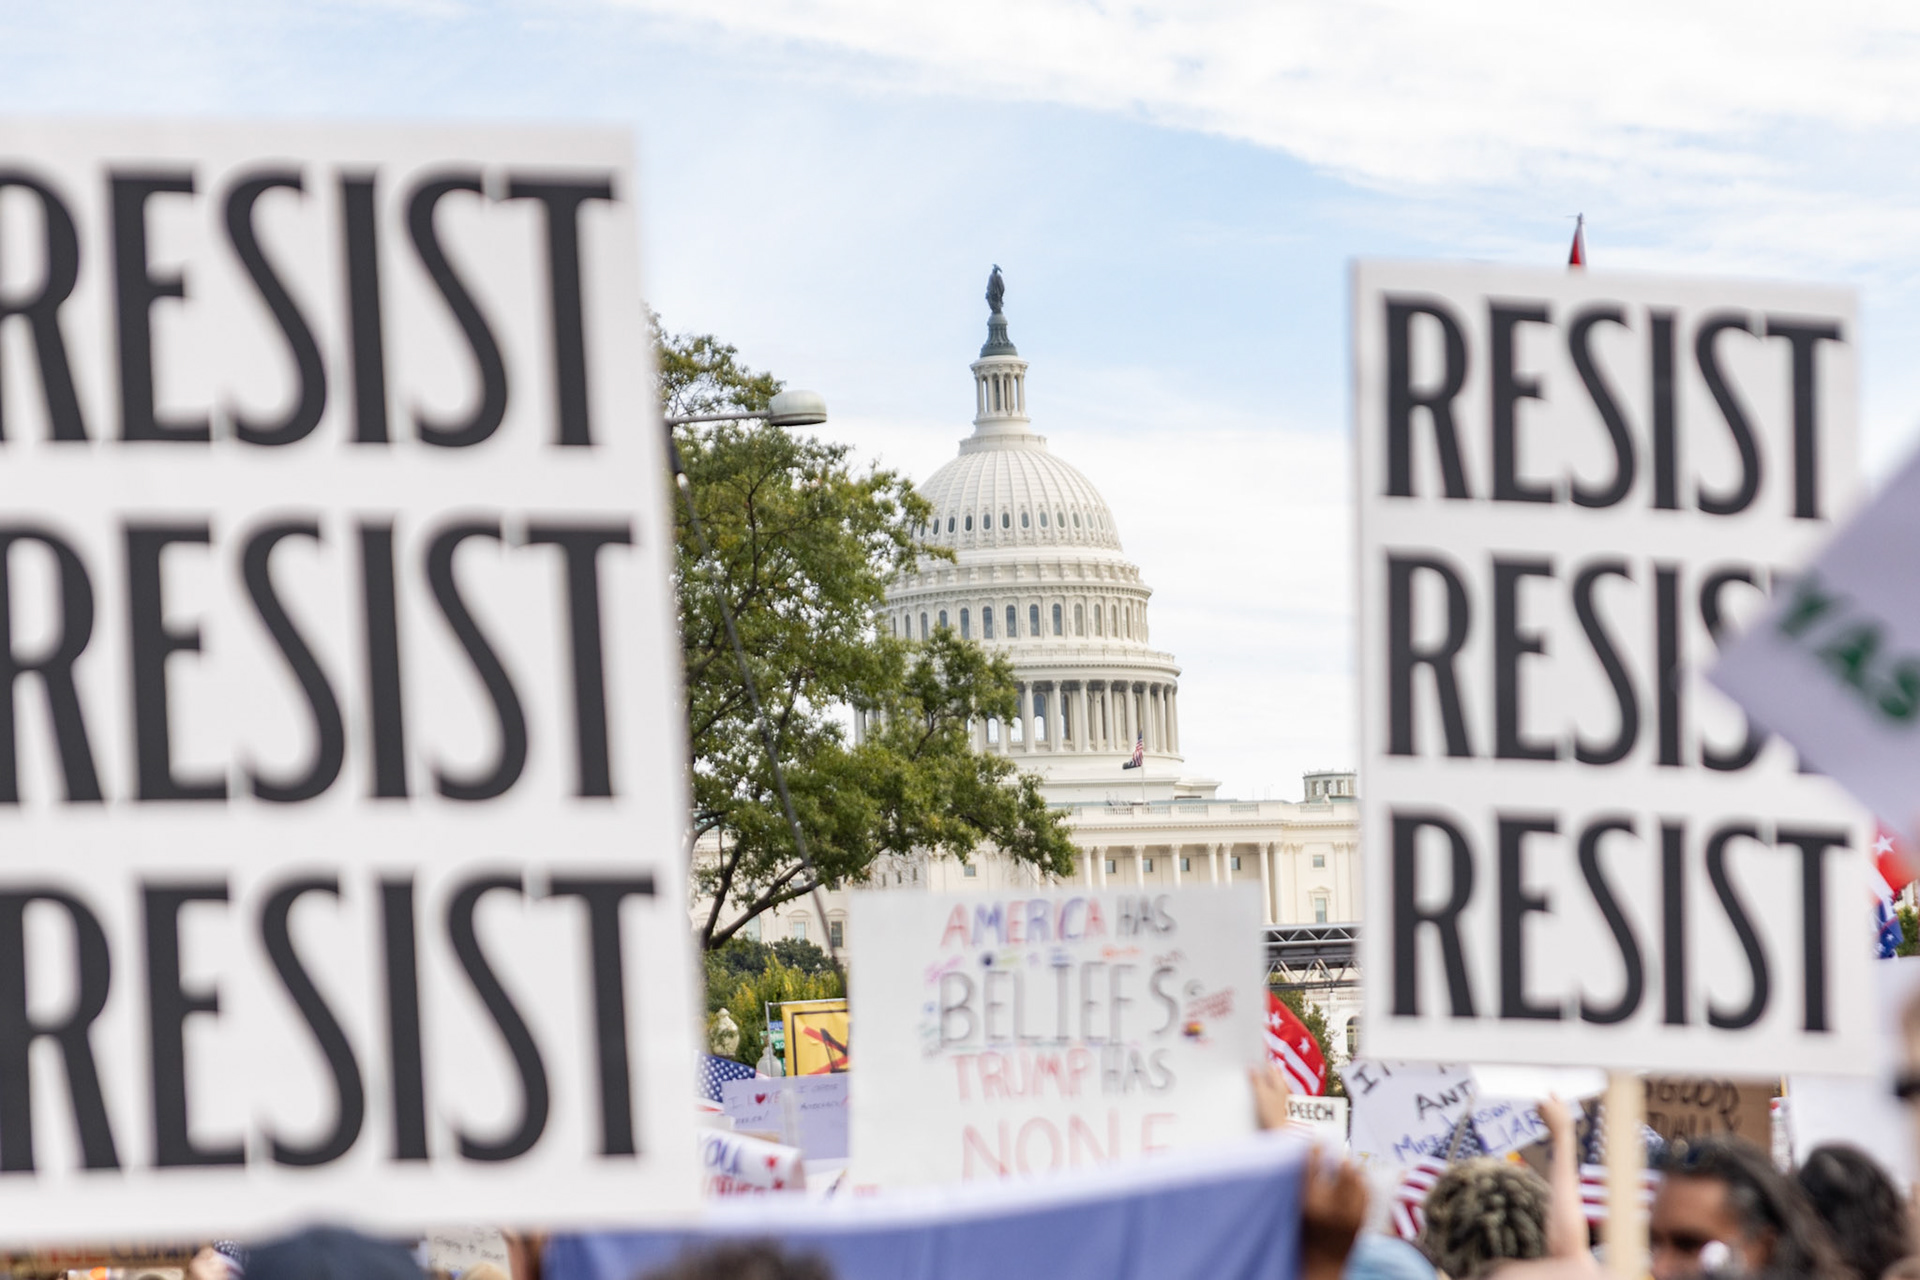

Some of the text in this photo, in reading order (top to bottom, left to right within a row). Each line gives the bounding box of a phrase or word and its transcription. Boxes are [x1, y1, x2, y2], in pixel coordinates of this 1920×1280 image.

[0, 167, 616, 447] RESIST
[1383, 295, 1843, 520] RESIST
[0, 519, 634, 802] RESIST
[1385, 548, 1800, 773] RESIS
[0, 869, 656, 1172] RESIST
[938, 962, 1181, 1047] BELIEFS
[940, 894, 1178, 946] AMERICA HAS
[1391, 808, 1849, 1032] RESIST
[951, 1044, 1177, 1102] TRUMP HAS
[1288, 1101, 1335, 1121] PEECH
